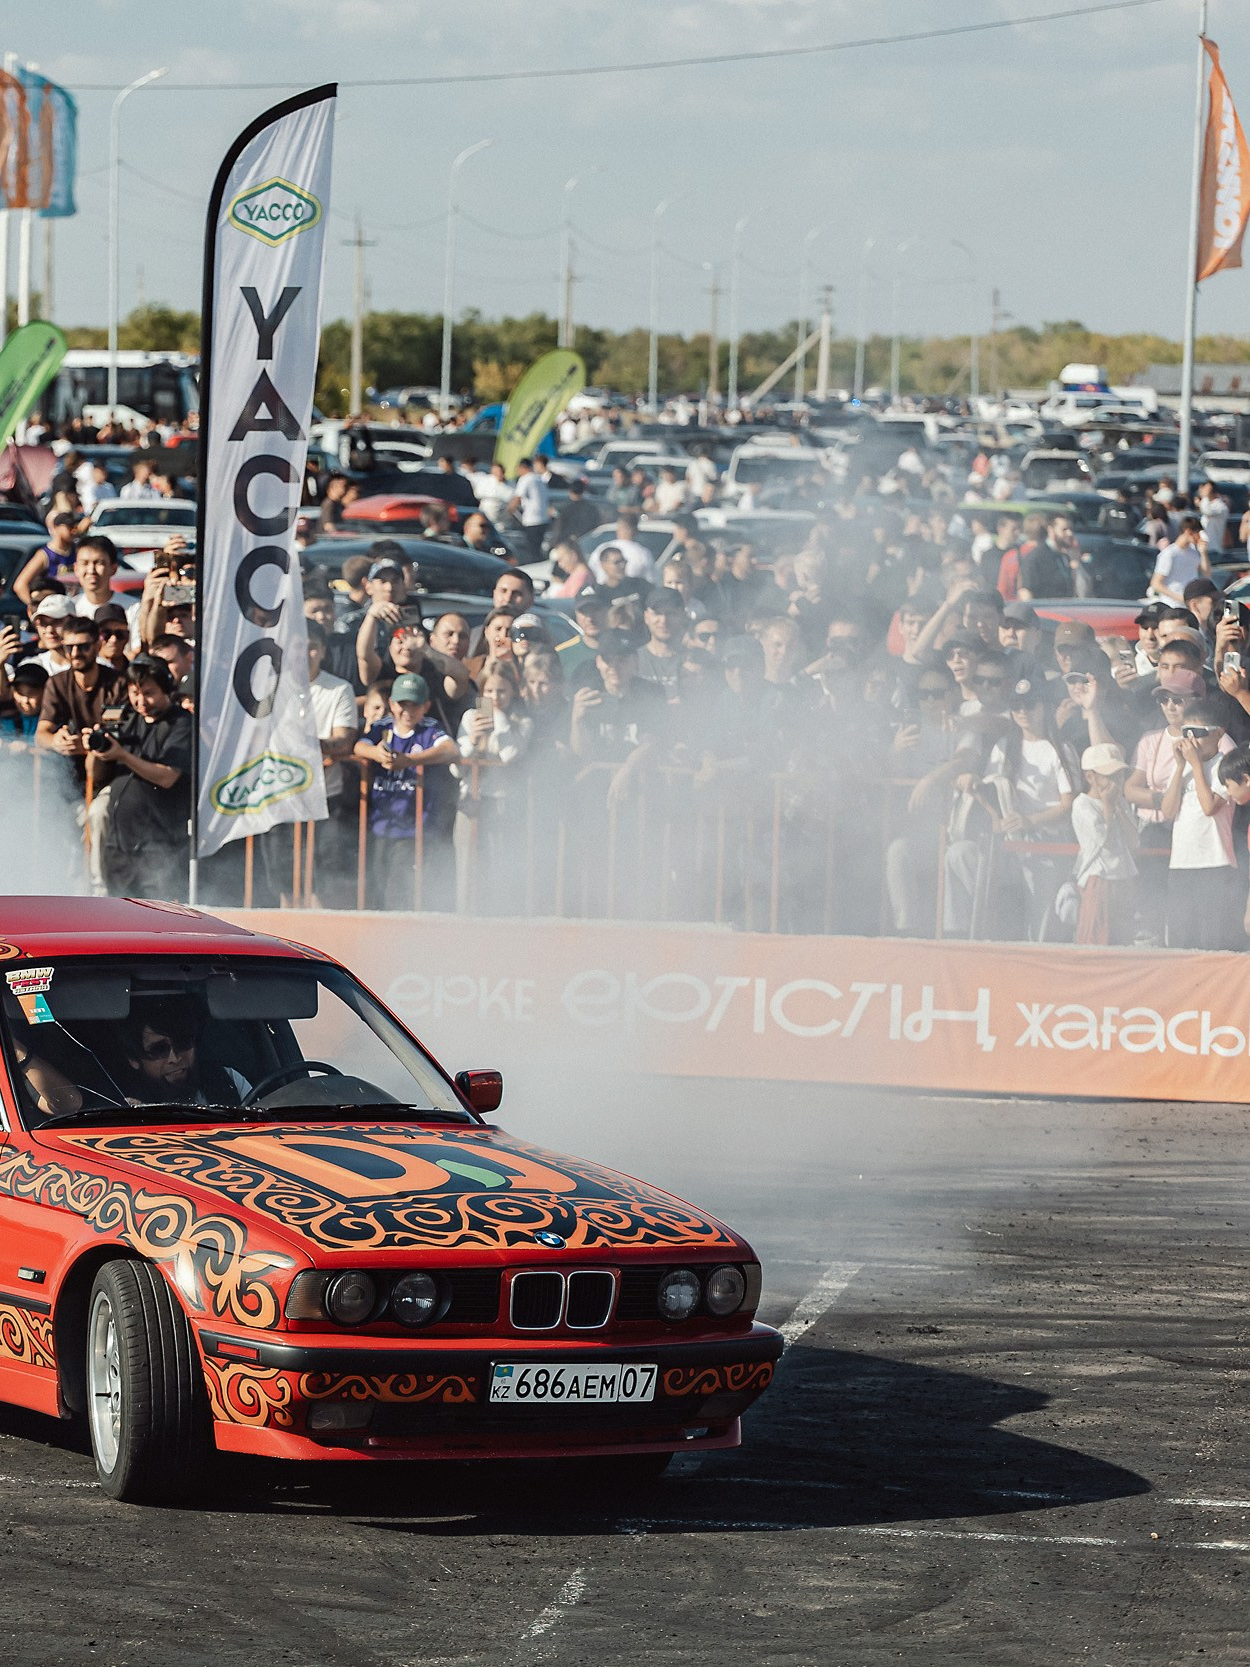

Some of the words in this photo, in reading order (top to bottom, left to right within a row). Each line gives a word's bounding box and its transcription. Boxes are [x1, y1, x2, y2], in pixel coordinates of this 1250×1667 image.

[243, 203, 305, 221] YACCO
[227, 286, 307, 719] YACCO
[6, 968, 53, 983] BMW
[492, 1386, 511, 1399] KZ
[515, 1368, 617, 1399] 686AEM
[622, 1367, 656, 1398] 07
